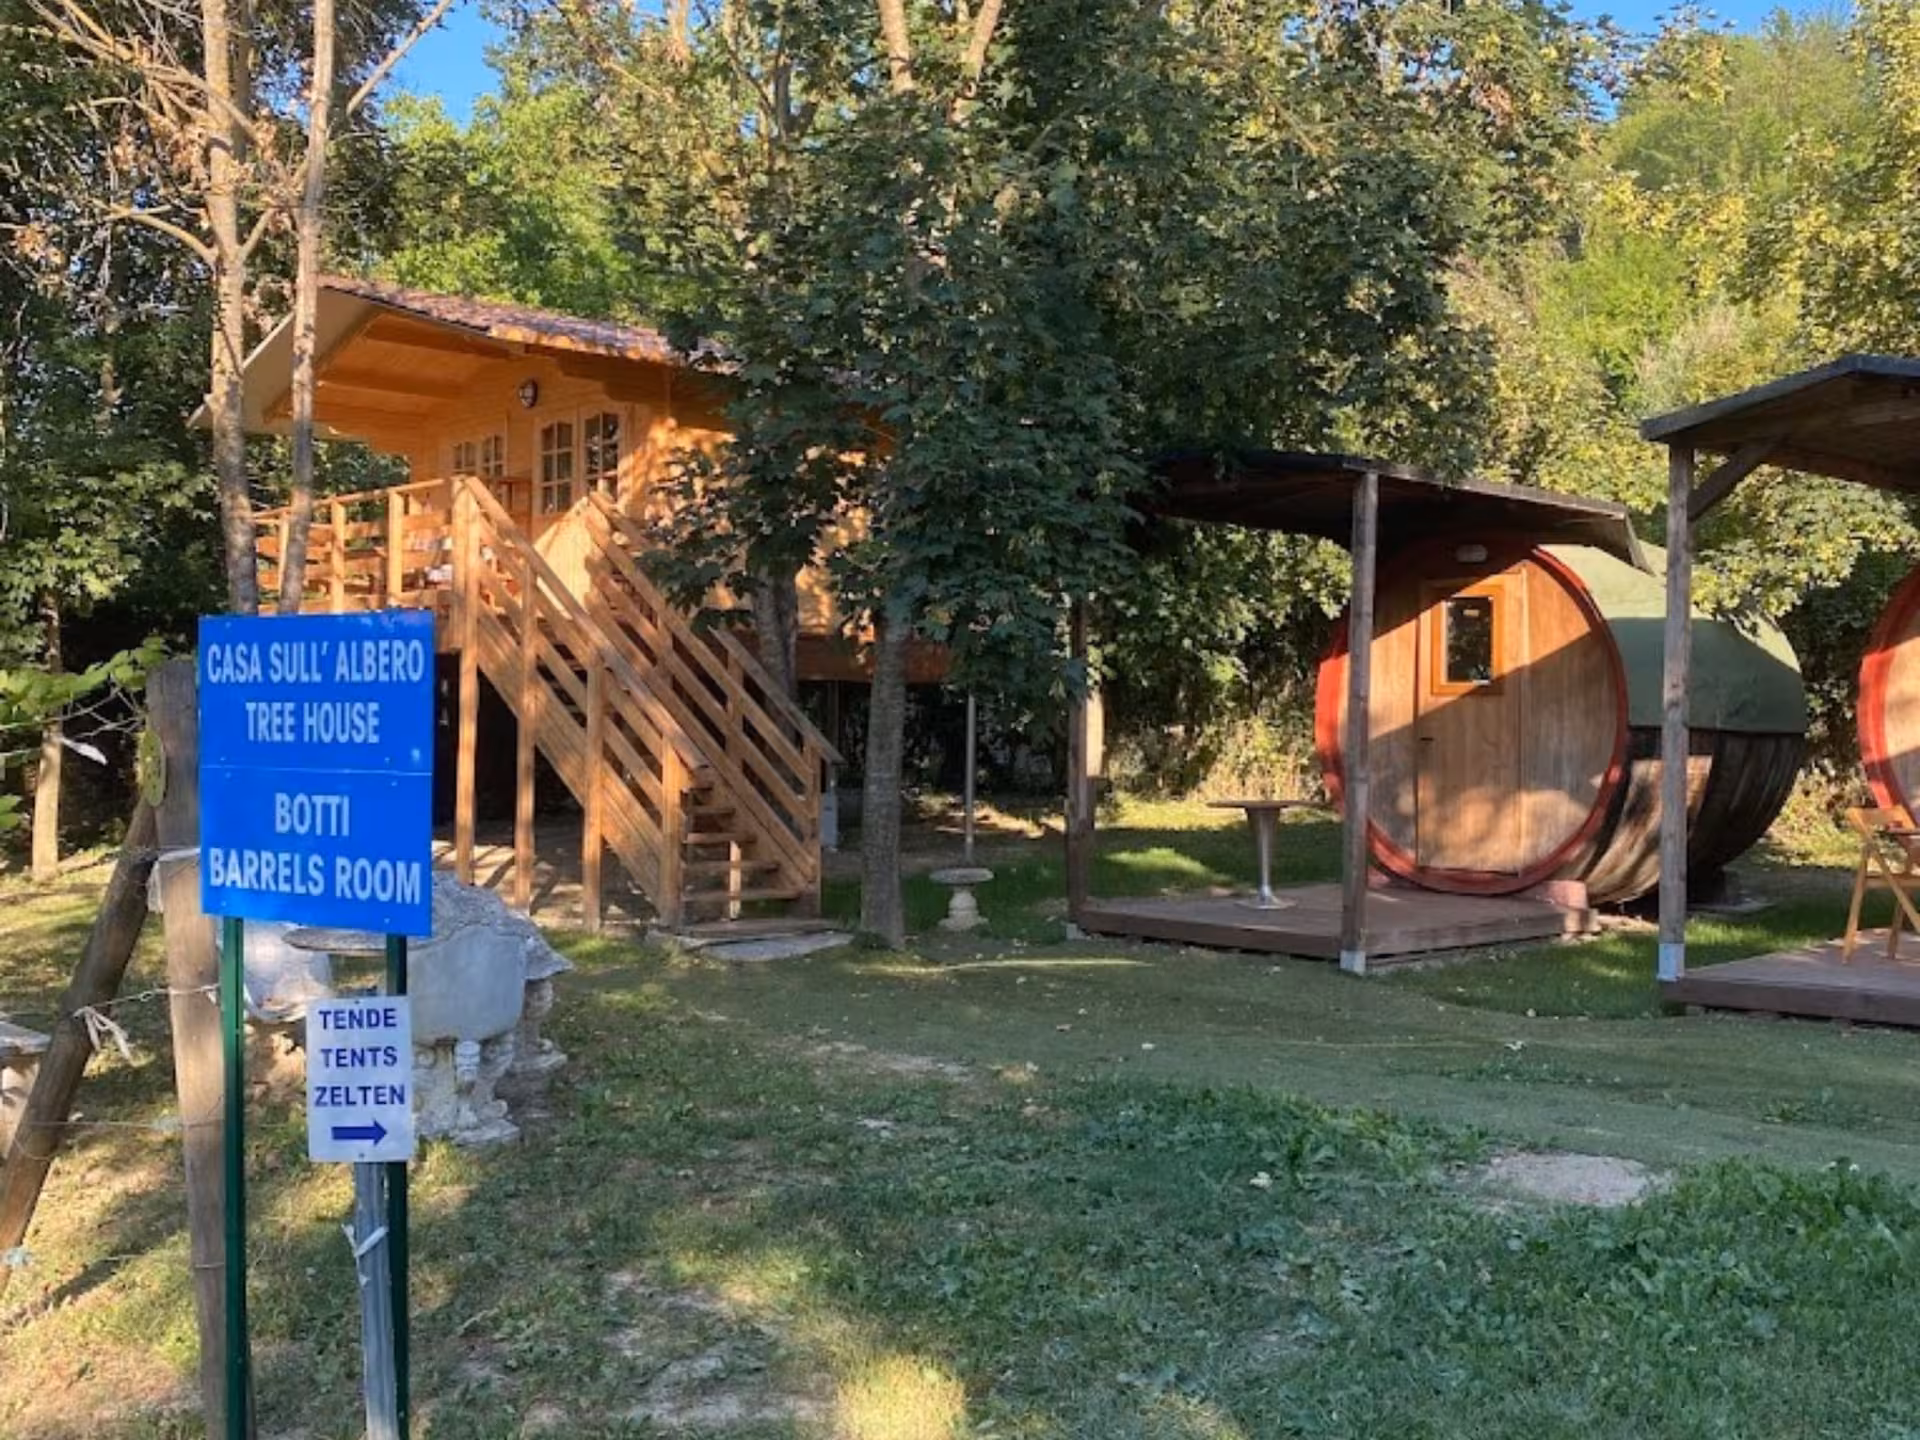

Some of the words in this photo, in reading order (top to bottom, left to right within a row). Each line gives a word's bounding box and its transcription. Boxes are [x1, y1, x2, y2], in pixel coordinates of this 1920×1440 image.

[207, 644, 262, 683] CASA
[269, 641, 328, 683] SULL'
[335, 639, 424, 682] ALBERO
[246, 702, 295, 742] TREE
[304, 702, 379, 743] HOUSE
[275, 792, 350, 836] BOTTI
[209, 847, 324, 896] BARRELS
[335, 856, 421, 905] ROOM
[318, 1008, 397, 1030] TENDE
[321, 1046, 398, 1068] TENTS
[314, 1084, 405, 1107] ZELTEN
